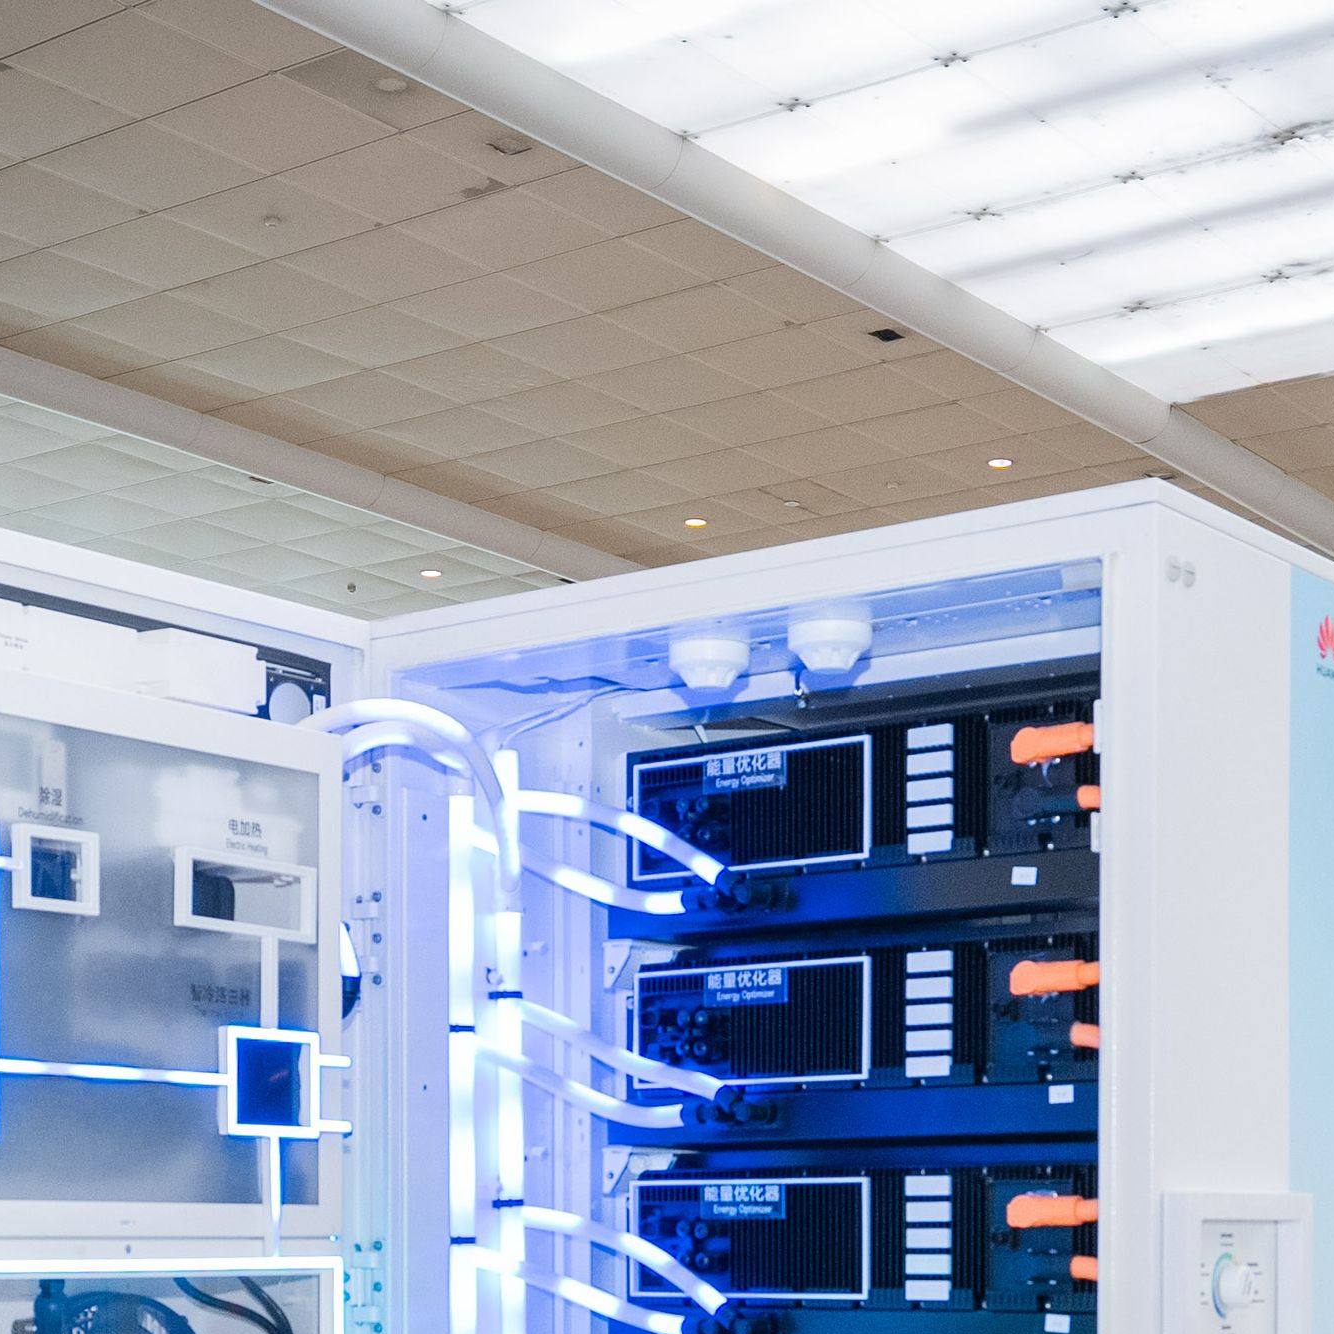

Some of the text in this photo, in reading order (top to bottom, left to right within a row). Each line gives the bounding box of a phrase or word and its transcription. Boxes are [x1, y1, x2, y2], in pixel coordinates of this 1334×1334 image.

[707, 751, 781, 777] 能量优化器
[716, 773, 775, 789] Energy Optimizer
[38, 785, 62, 807] 除湿
[18, 806, 84, 826] Dehumidification
[228, 819, 262, 838] 电加热
[708, 968, 782, 989] 能量优化器
[716, 989, 775, 1002] Energy Optimizer
[704, 1185, 780, 1202] 能量优化器
[713, 1203, 772, 1216] Energy Optimizer
